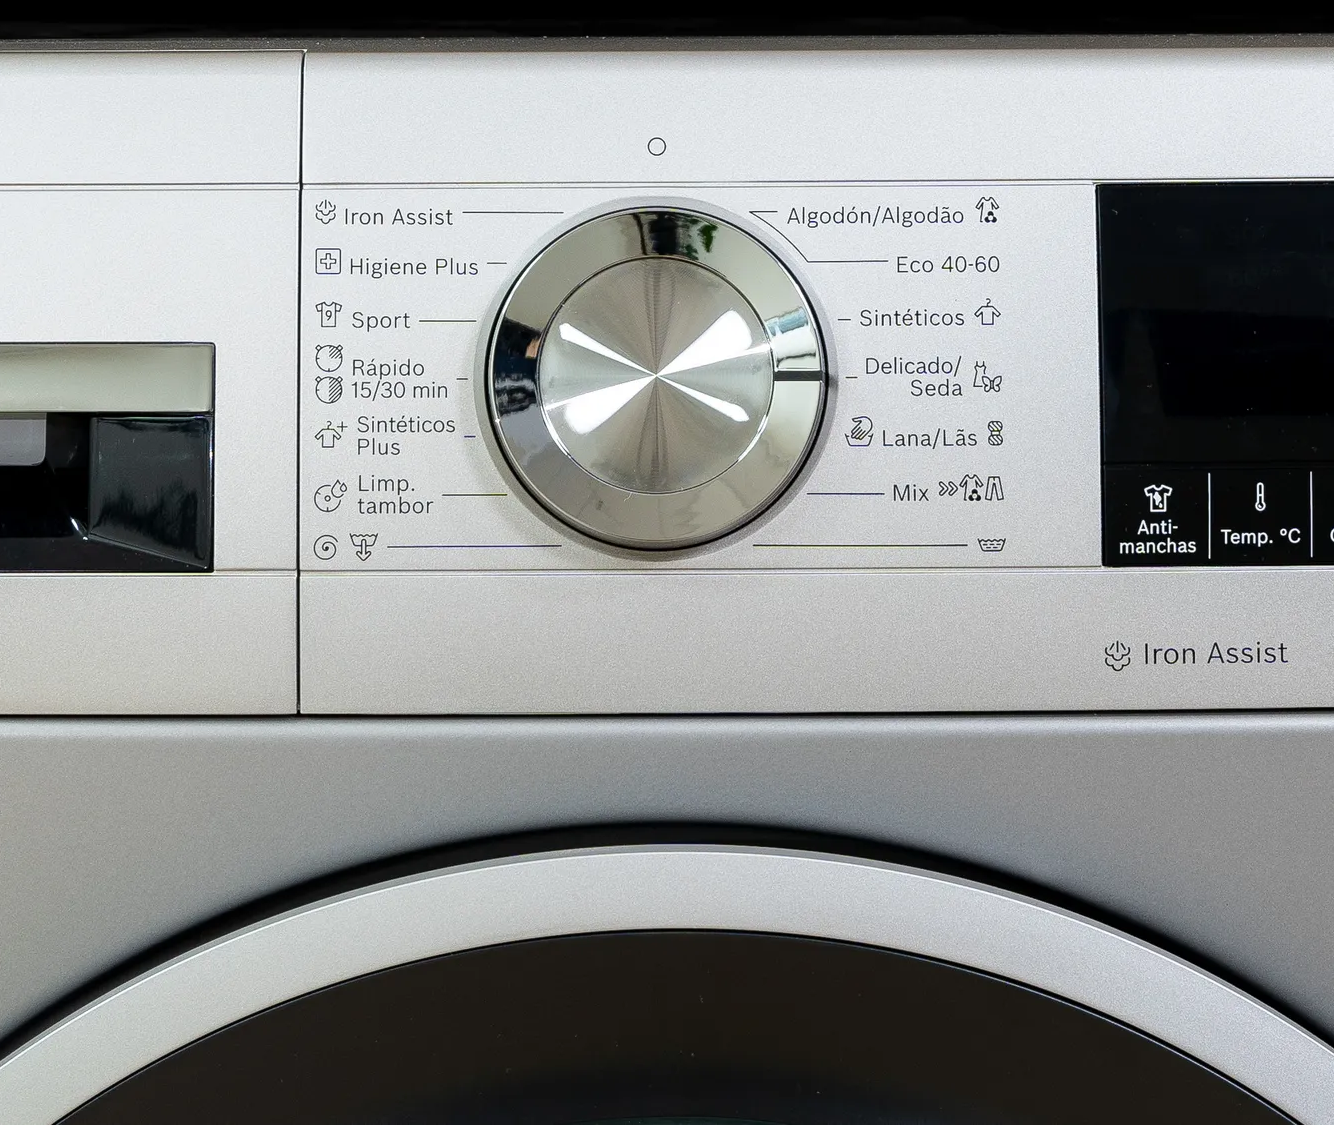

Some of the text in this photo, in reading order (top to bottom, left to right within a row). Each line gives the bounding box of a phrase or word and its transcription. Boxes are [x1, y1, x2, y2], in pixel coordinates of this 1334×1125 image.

[344, 208, 454, 225] Iron Assist
[787, 205, 965, 228] Algodón/Algodão
[350, 258, 479, 279] Higiene Plus
[896, 256, 1000, 273] Eco 40-60
[351, 311, 411, 332] Sport
[860, 308, 965, 326] Sintéticos
[352, 358, 425, 380] Rápido
[865, 356, 962, 377] Delicado/
[351, 381, 448, 401] 15/30 min
[910, 379, 963, 397] Seda
[357, 415, 456, 433] Sintéticos
[357, 438, 401, 456] Plus
[882, 428, 977, 449] Lana/Lãs
[358, 474, 415, 496] Limp.
[893, 484, 929, 502] Mix
[358, 496, 434, 514] tambor
[1137, 519, 1178, 535] Anti-
[1119, 537, 1197, 554] manchas
[1221, 528, 1301, 548] Temp. °C
[1144, 641, 1288, 665] Iron Assist
